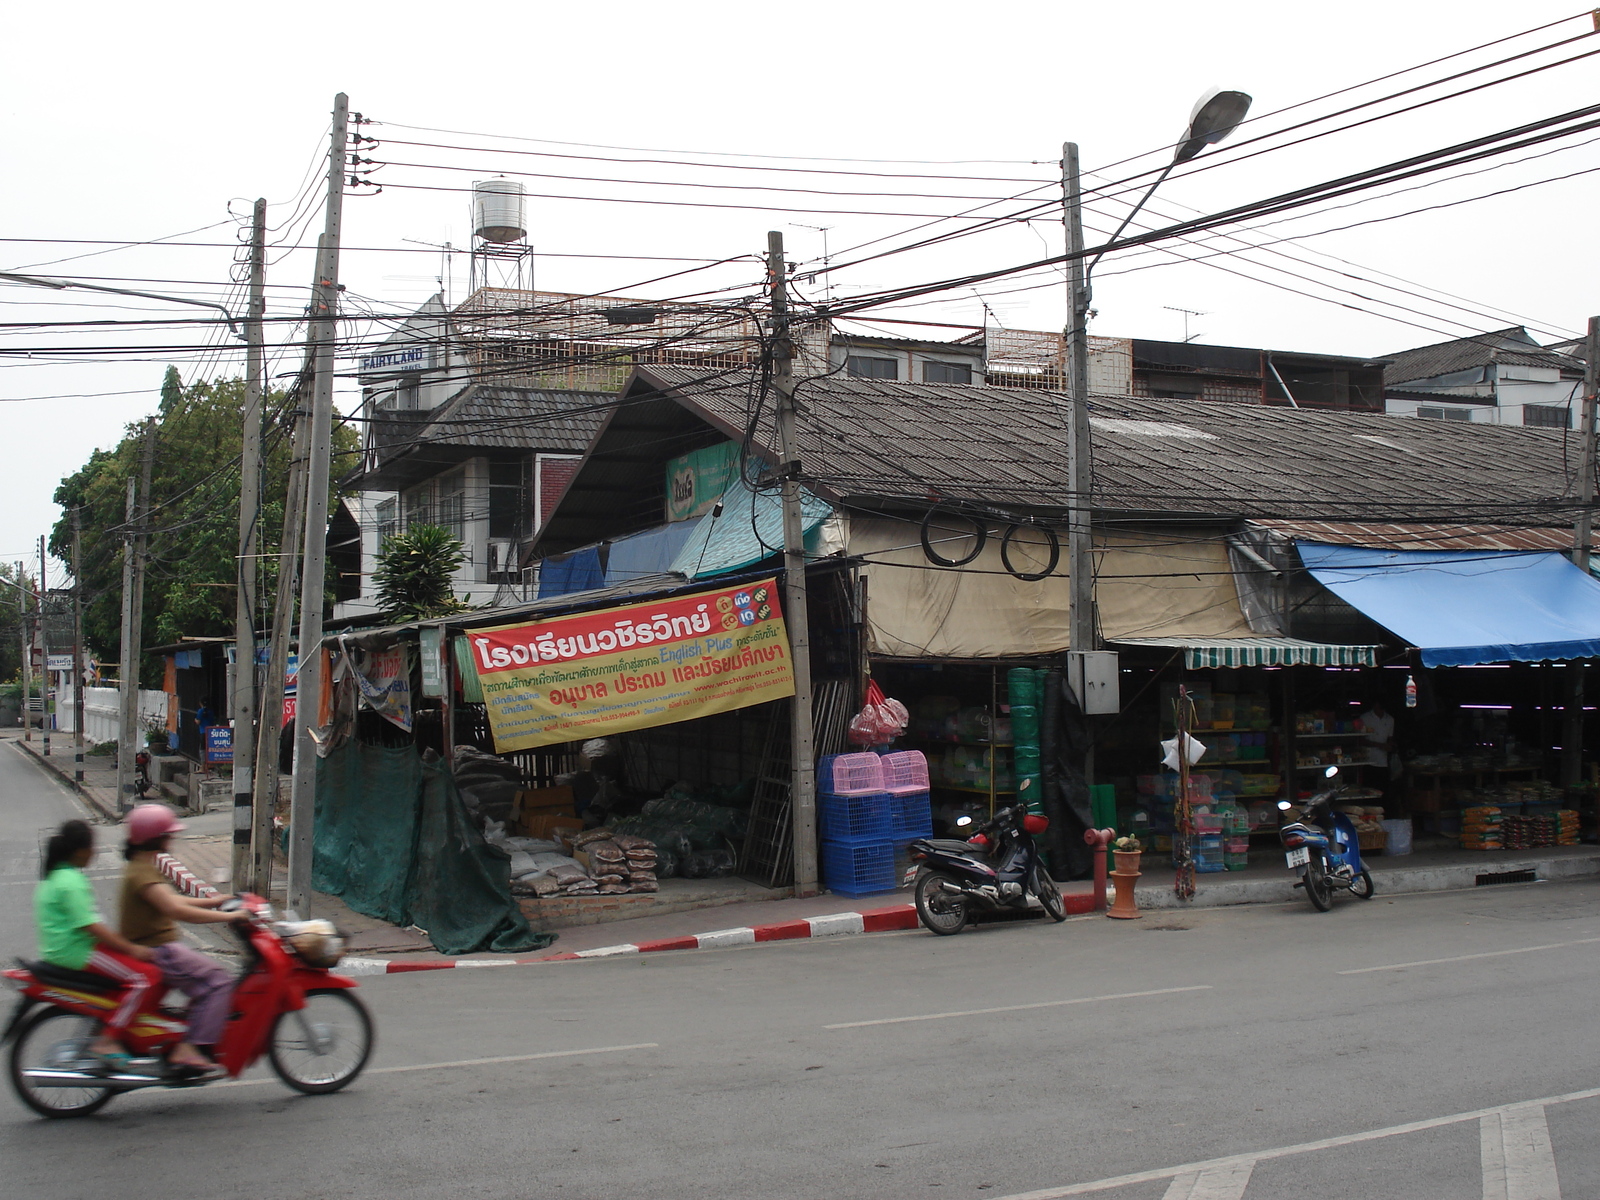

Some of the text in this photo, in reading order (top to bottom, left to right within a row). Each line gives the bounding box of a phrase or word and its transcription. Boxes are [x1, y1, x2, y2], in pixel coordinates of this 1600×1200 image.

[363, 348, 423, 371] FAIRYLAND
[735, 592, 750, 605] เก่ง
[724, 604, 770, 627] EQ IQ MQ
[475, 604, 711, 668] โรงเรียนวชิรวิทย์
[659, 639, 701, 664] English
[706, 636, 733, 652] Plus
[549, 644, 783, 708] อนุบาล ประถม และมัธยมศึกษา
[693, 666, 786, 691] www.wachirawit.ac.th
